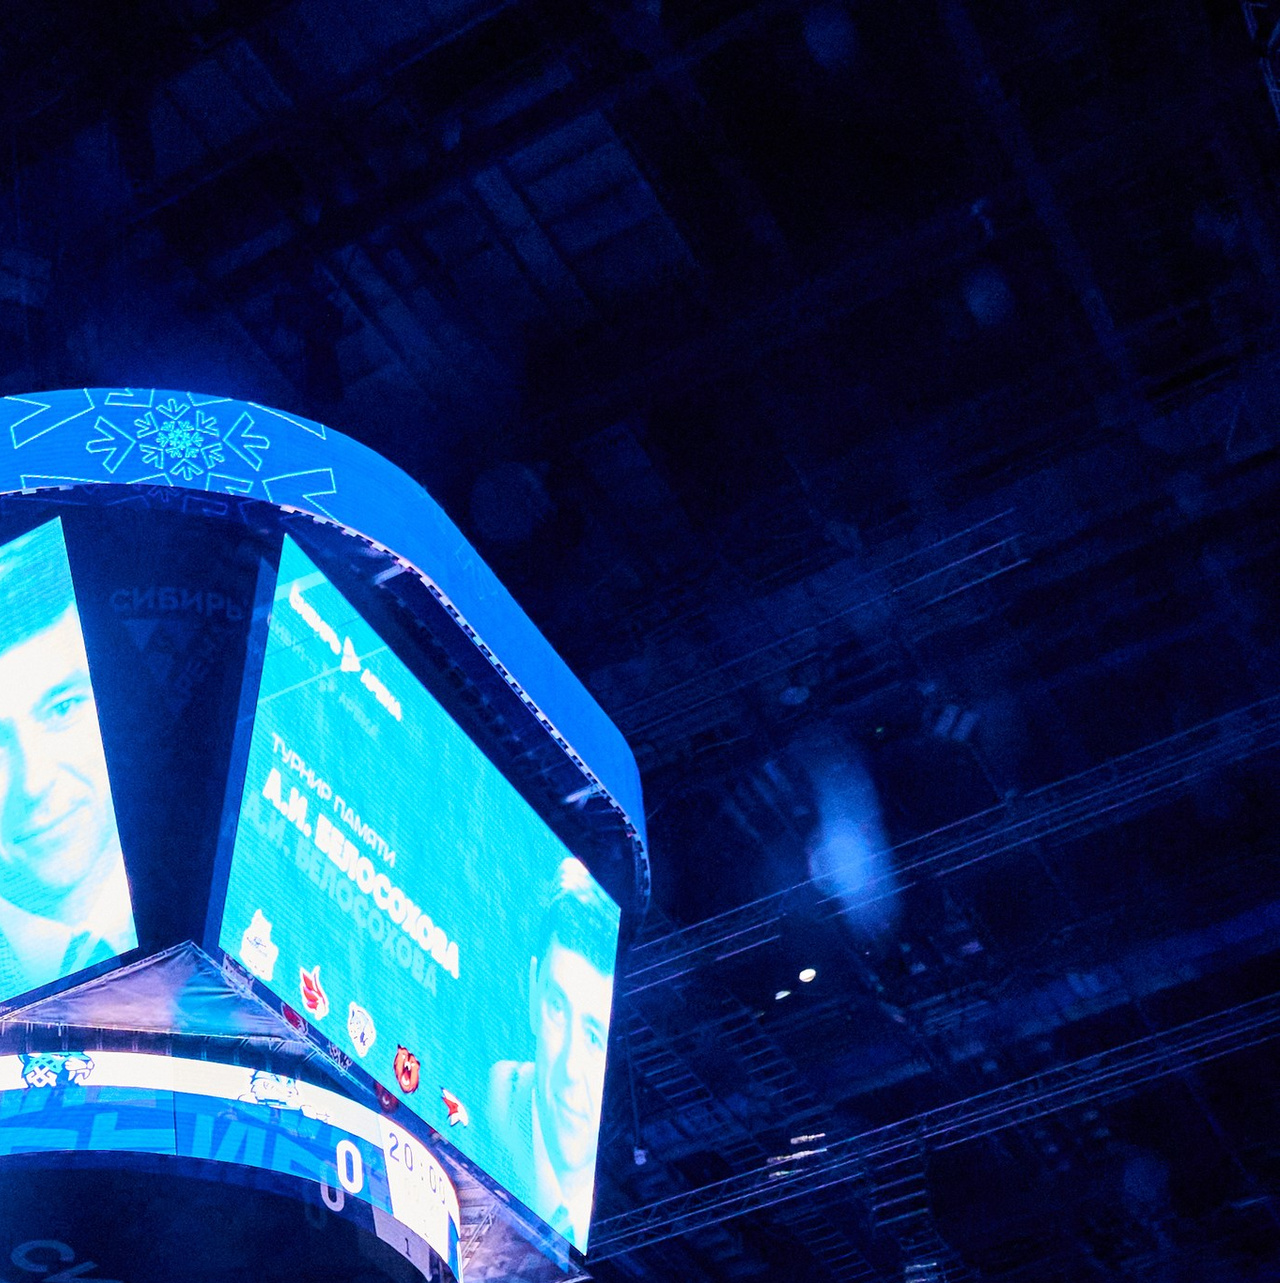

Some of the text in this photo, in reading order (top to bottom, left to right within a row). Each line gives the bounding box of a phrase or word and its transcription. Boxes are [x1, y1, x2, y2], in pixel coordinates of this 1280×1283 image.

[109, 585, 244, 622] СИБИРЬ
[271, 732, 333, 801] ТУРНИР
[333, 795, 397, 868] ПАМЯТИ
[262, 767, 459, 980] А.И. БЕЛОСОХОВА
[336, 1140, 363, 1194] 0
